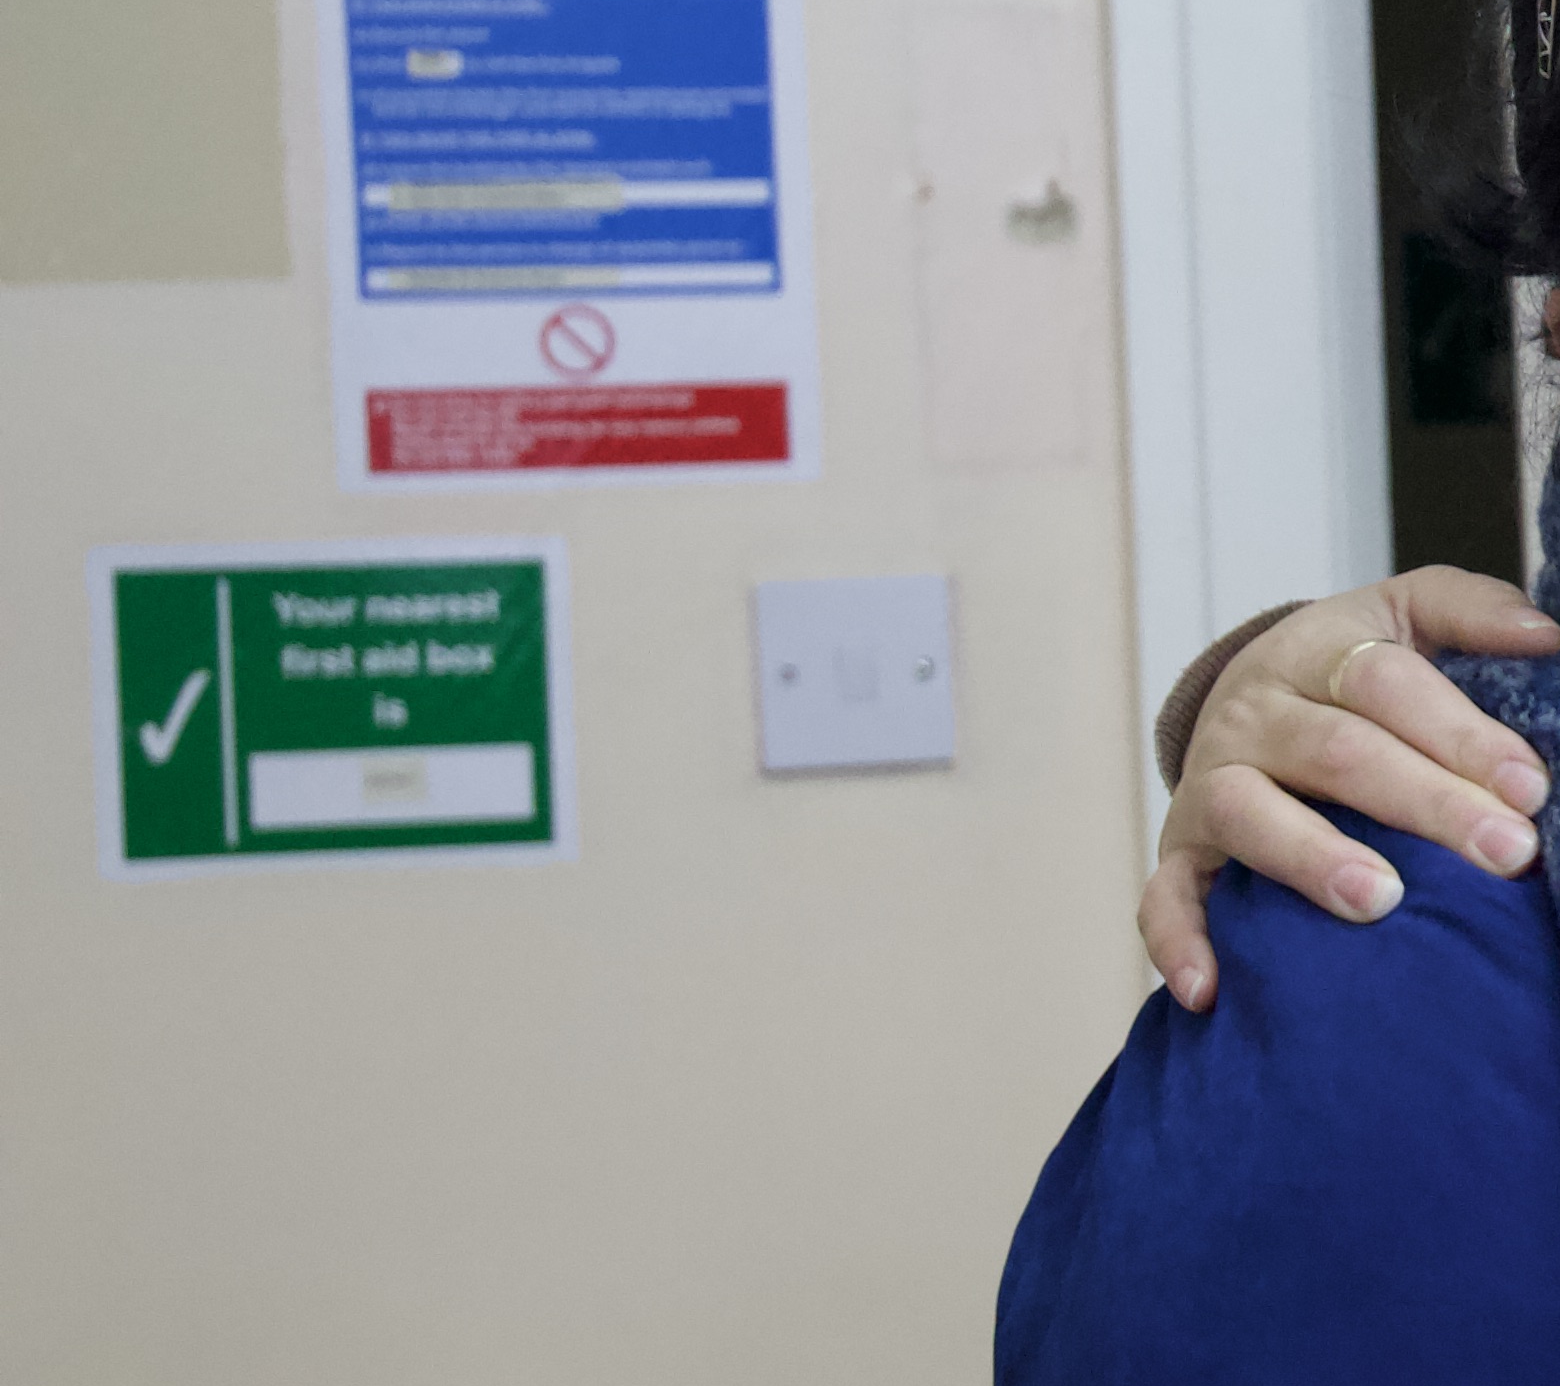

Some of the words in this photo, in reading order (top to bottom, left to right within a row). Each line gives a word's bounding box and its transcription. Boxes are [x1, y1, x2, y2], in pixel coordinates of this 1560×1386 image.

[271, 590, 357, 629] Your
[364, 588, 500, 625] nearest
[280, 642, 356, 679] first
[361, 639, 420, 678] aid
[425, 639, 495, 677] box
[371, 691, 409, 730] is
